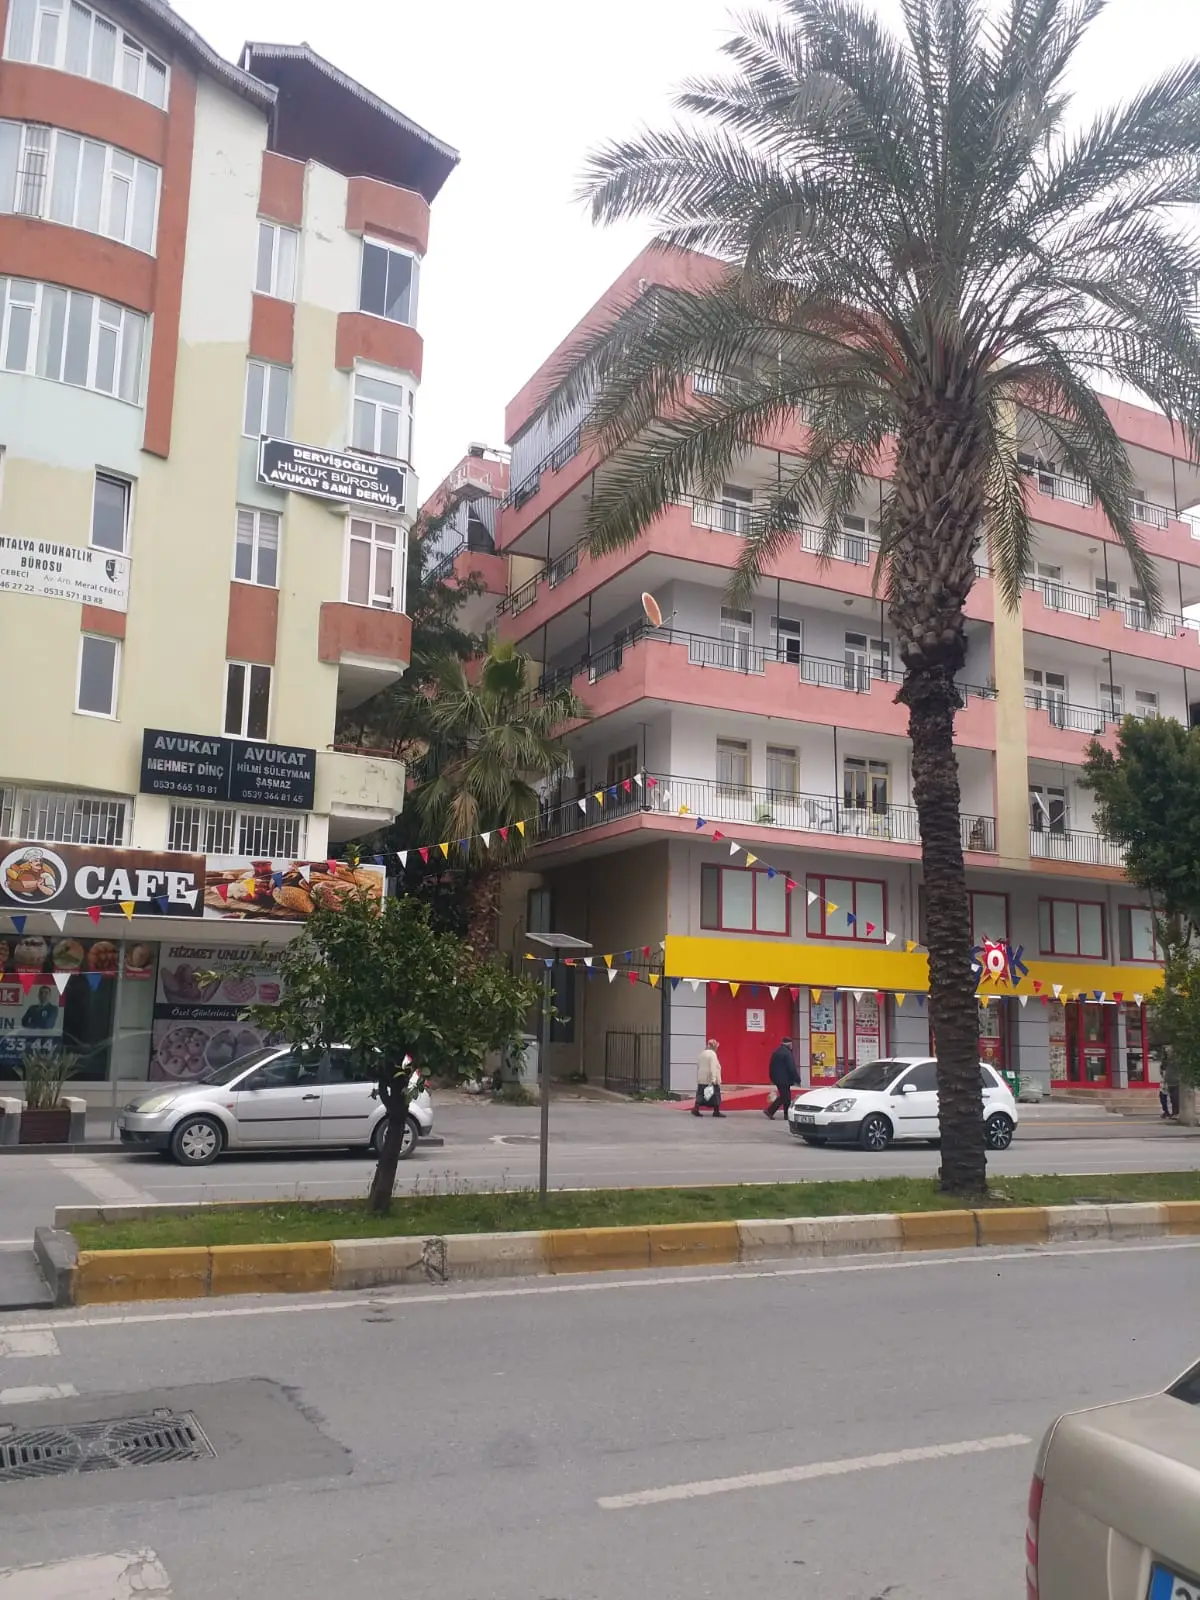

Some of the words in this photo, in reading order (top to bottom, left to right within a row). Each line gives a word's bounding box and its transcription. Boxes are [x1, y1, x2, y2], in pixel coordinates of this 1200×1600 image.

[293, 448, 379, 475] DERVİŞOĞLU
[277, 461, 328, 479] HUKUK
[331, 472, 389, 493] BÜROSU
[270, 469, 319, 488] AVUKAT
[321, 480, 352, 496] SAMİ
[356, 488, 398, 506] DERVİŞ
[38, 542, 93, 563] AVUKATLIK
[21, 556, 63, 573] BÜROSU
[11, 582, 23, 591] 27
[24, 584, 35, 592] 22
[154, 736, 221, 756] AVUKAT
[244, 747, 307, 766] AVUKAT
[147, 757, 196, 774] MEHMET
[197, 761, 225, 780] DİNÇ
[236, 761, 262, 774] HİLMİ
[263, 765, 311, 780] SÜLEYMAN
[153, 780, 175, 790] 0533
[176, 782, 193, 792] 665
[195, 784, 206, 793] 18
[207, 785, 217, 794] 81
[255, 777, 292, 790] ŞAŞMAZ
[74, 865, 195, 904] CAFE
[168, 945, 213, 959] HİZMET
[217, 949, 249, 960] UNLU
